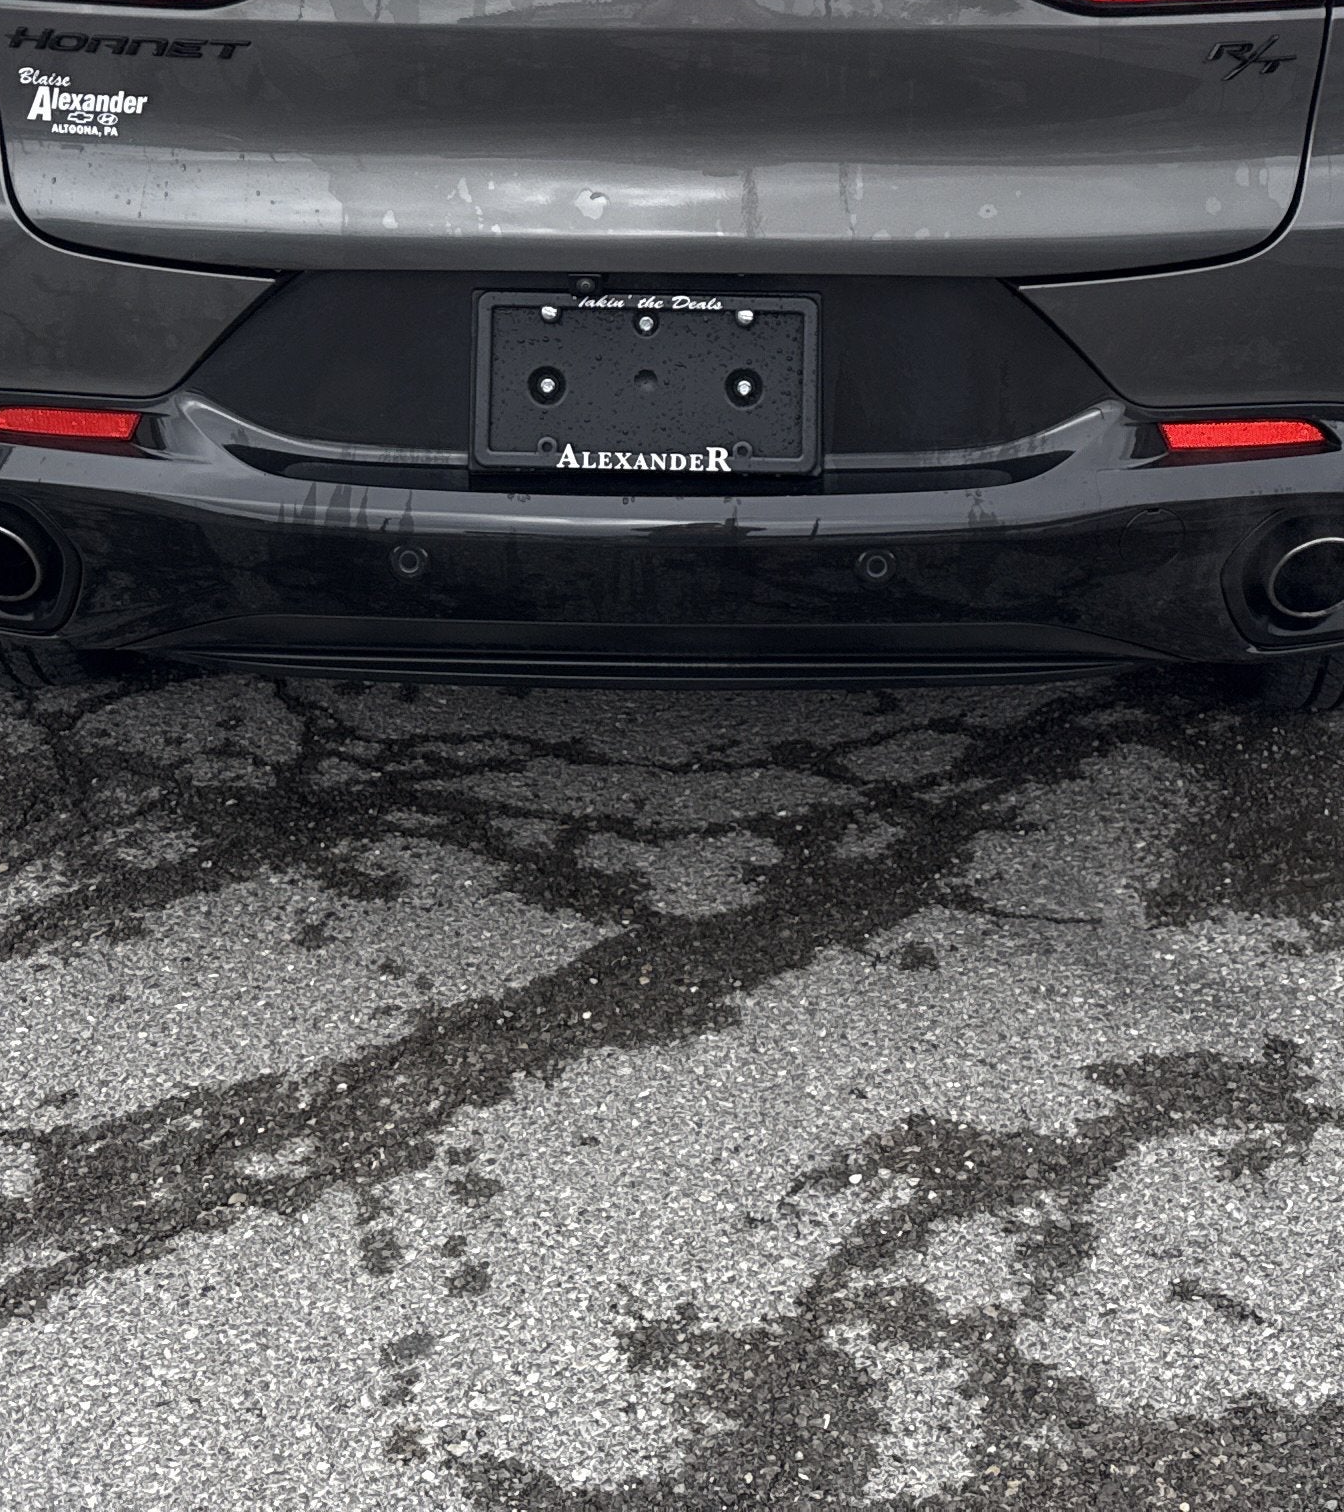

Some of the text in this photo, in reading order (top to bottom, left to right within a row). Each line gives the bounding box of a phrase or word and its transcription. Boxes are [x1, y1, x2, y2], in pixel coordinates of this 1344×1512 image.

[7, 26, 252, 60] HORNET
[1206, 34, 1297, 81] R/T
[18, 67, 72, 87] Blaise
[27, 85, 149, 121] Alexander
[51, 123, 119, 138] ALTOONA, PA
[638, 295, 665, 309] the
[671, 295, 724, 310] Deals
[556, 443, 732, 473] ALEXANDER
